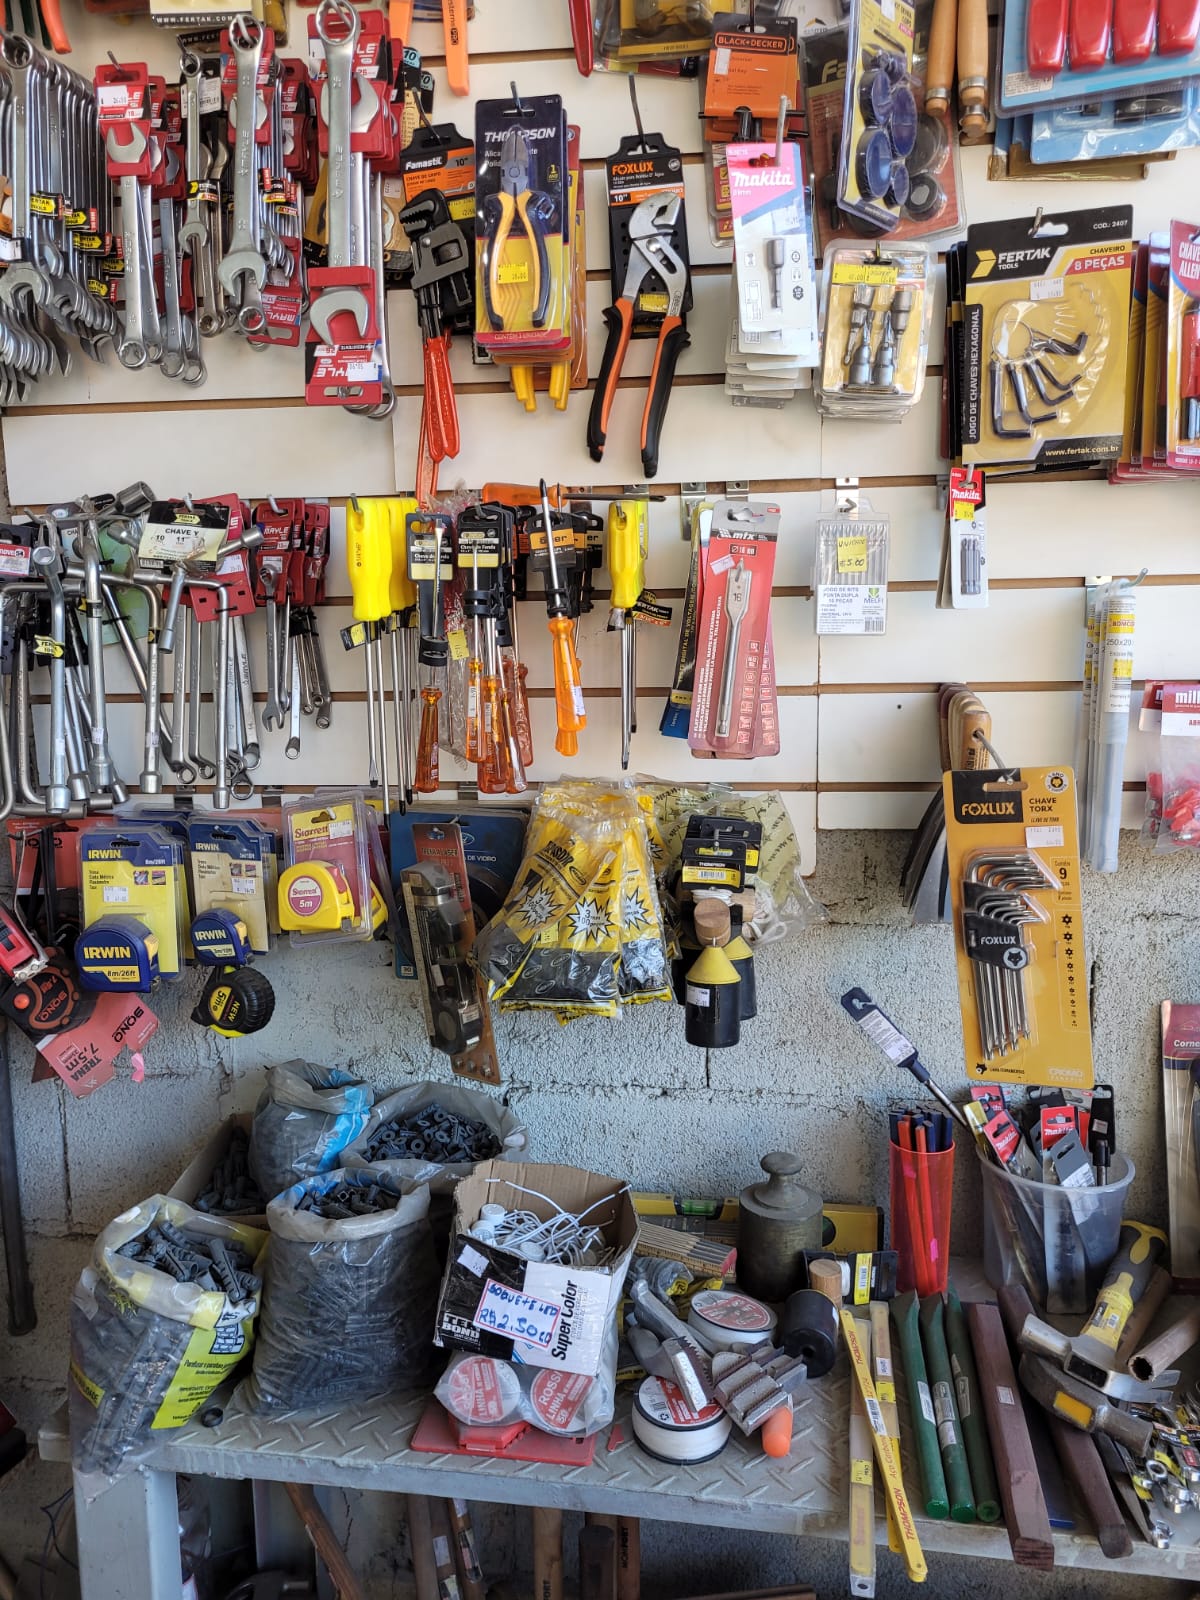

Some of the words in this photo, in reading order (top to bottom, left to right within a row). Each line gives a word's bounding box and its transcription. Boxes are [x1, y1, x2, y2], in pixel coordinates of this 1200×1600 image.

[718, 37, 783, 48] BLACK+DECKER
[484, 127, 556, 143] THOPSON
[406, 156, 443, 171] Famastil
[612, 160, 654, 176] FOXLUX
[997, 247, 1052, 264] FERTAK
[1090, 245, 1126, 255] CHAVEIRO
[998, 262, 1019, 271] TOOLS
[1074, 261, 1082, 271] 8
[1084, 255, 1125, 271] PEÇAS
[970, 308, 979, 365] HEXAGONAL
[970, 366, 978, 401] CHAVES
[969, 402, 977, 415] DE
[969, 416, 977, 439] JOGO
[1045, 446, 1119, 456] www.fertak.com.br
[165, 528, 191, 536] CHAVE
[734, 593, 742, 602] 16
[1029, 797, 1057, 805] CHAVE
[961, 802, 1015, 816] FOXLUX
[1029, 805, 1053, 813] TORX
[294, 826, 328, 839] Starrett
[195, 842, 220, 851] IRWIN
[88, 849, 122, 859] IRWIN
[1059, 867, 1068, 880] 9
[299, 899, 313, 908] 5m
[194, 929, 227, 941] IRWIN
[980, 935, 1017, 946] FOXLUX
[83, 946, 131, 959] IRWIN
[107, 969, 136, 977] 8m/26ft
[228, 1001, 240, 1023] NEW
[64, 1042, 100, 1074] 7,5m
[70, 1054, 102, 1083] TRENA
[561, 1280, 578, 1318] Color
[442, 1322, 481, 1339] BOND
[551, 1318, 572, 1361] Super
[545, 1392, 566, 1420] LINHA
[895, 1488, 914, 1541] THOMPSON
